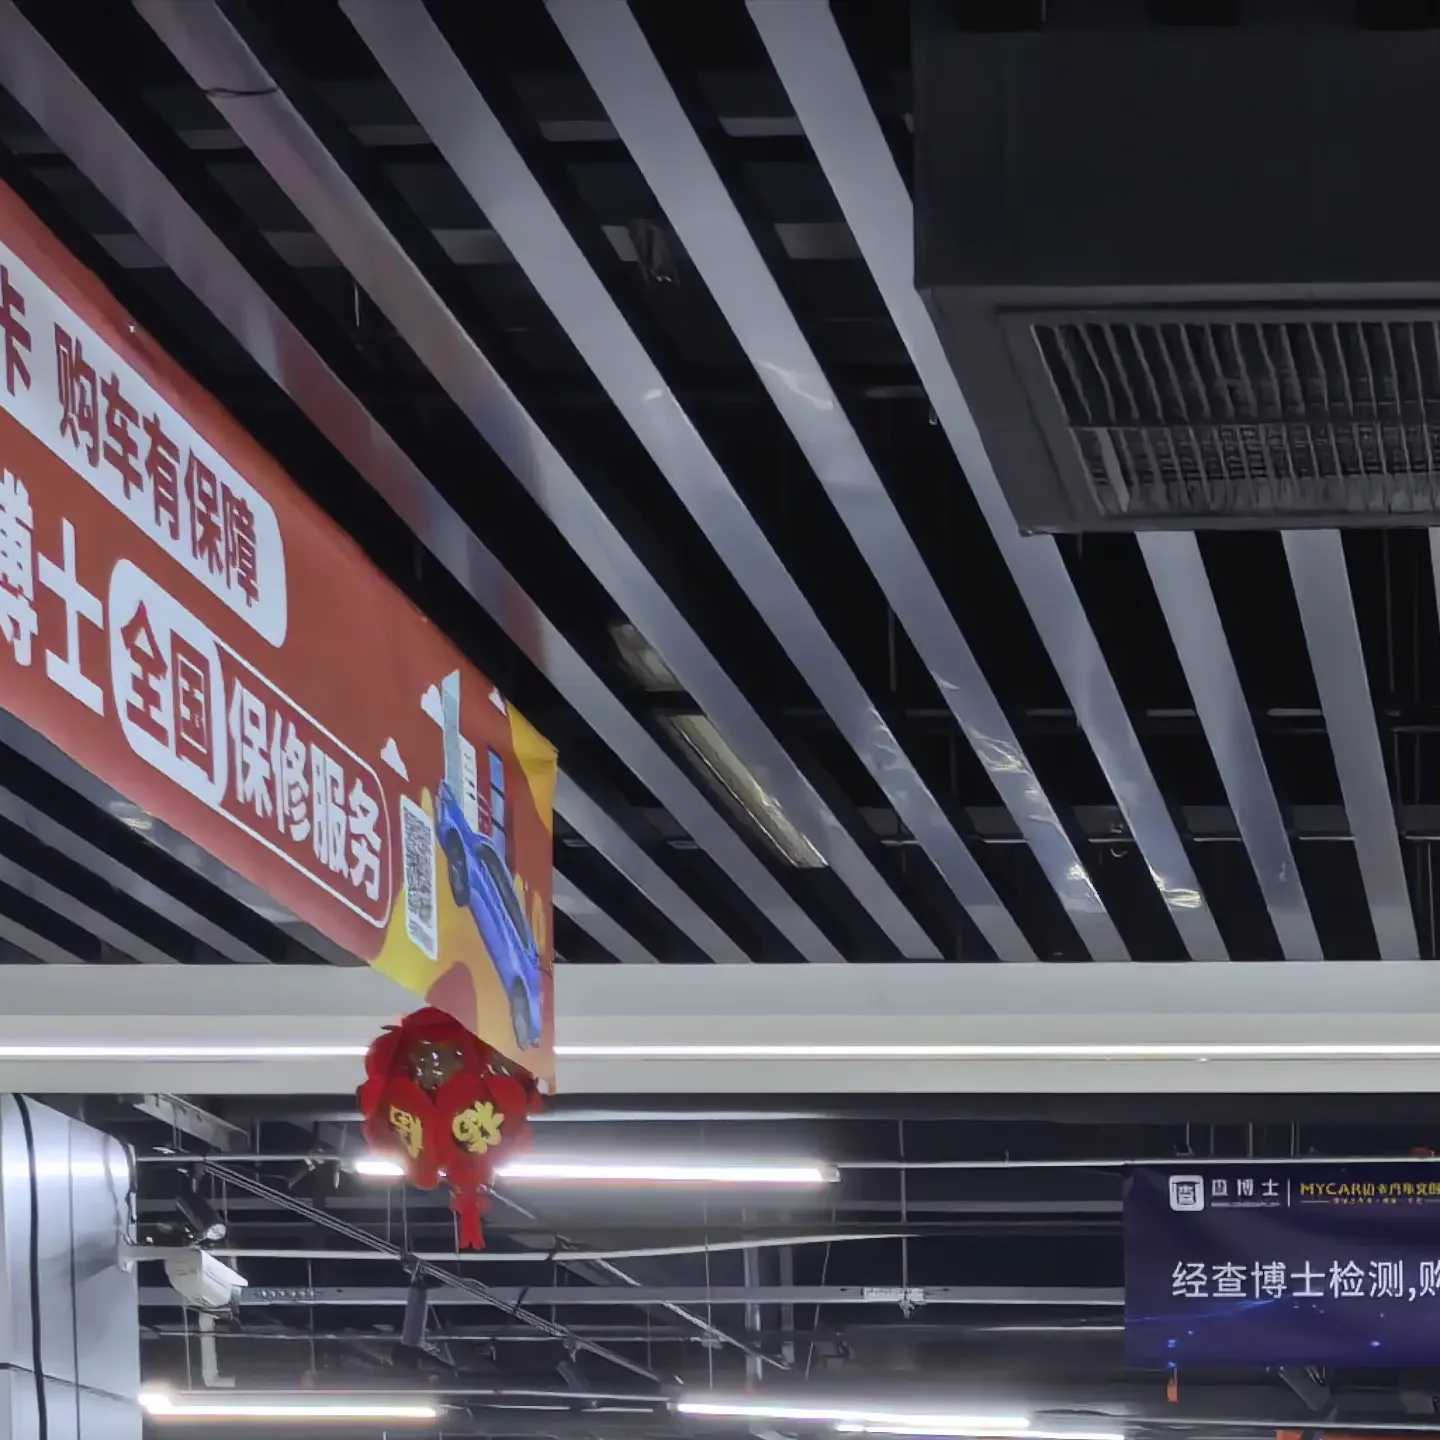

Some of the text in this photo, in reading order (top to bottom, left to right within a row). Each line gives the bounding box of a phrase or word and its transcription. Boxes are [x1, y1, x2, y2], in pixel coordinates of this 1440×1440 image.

[56, 330, 263, 611] 购车有保障
